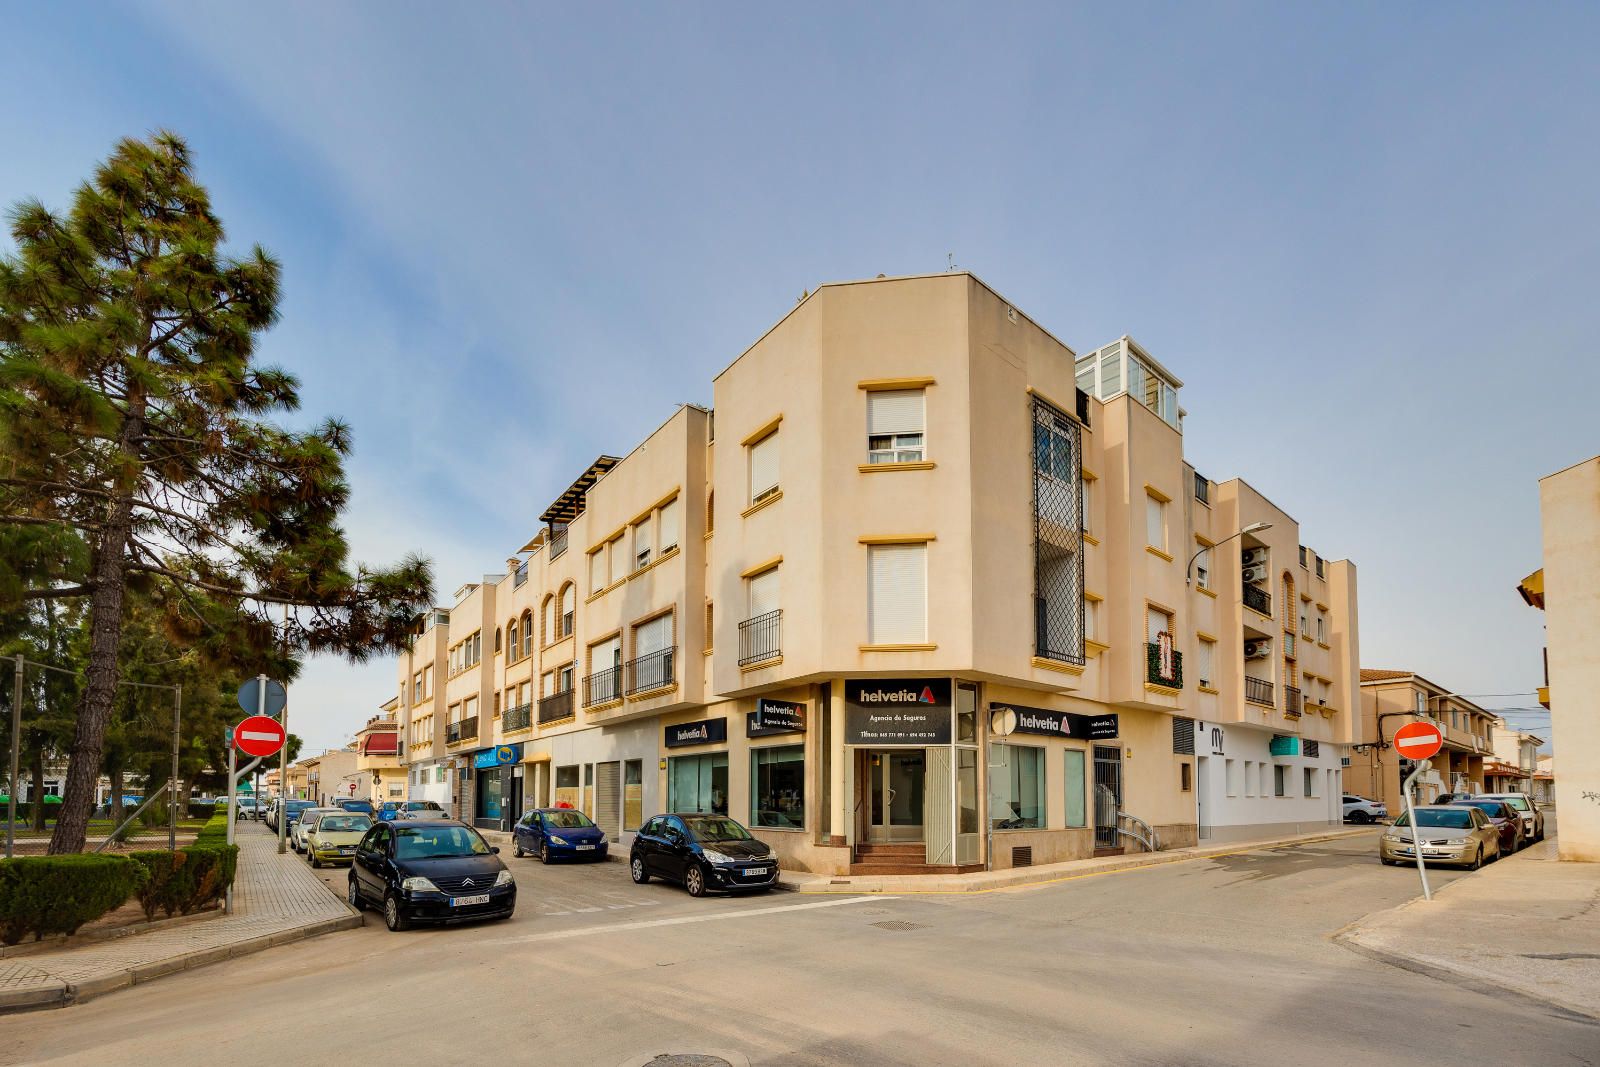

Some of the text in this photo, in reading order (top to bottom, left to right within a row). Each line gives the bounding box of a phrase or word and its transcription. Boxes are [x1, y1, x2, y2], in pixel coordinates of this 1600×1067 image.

[860, 689, 917, 702] helvetia
[764, 703, 794, 715] helvetia
[869, 714, 893, 722] Agencia
[903, 714, 927, 722] Seguros
[1020, 713, 1059, 731] helvetia
[677, 729, 700, 741] helvetia
